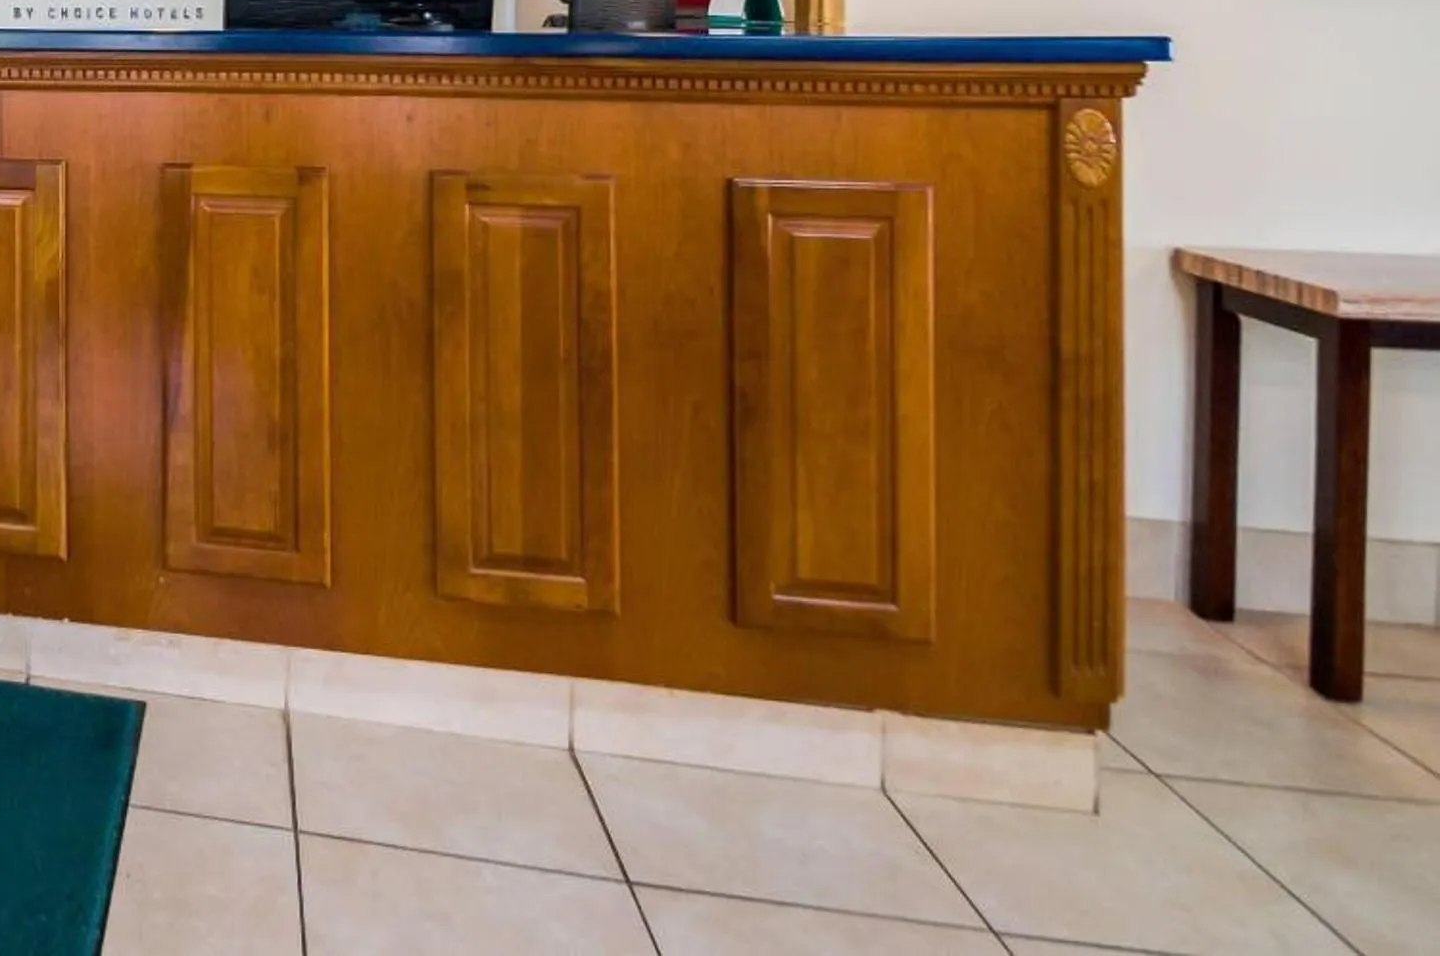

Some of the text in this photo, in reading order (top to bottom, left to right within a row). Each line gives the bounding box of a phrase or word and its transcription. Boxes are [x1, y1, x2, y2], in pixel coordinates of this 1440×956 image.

[13, 6, 205, 20] BY CHOICE HOTELS
